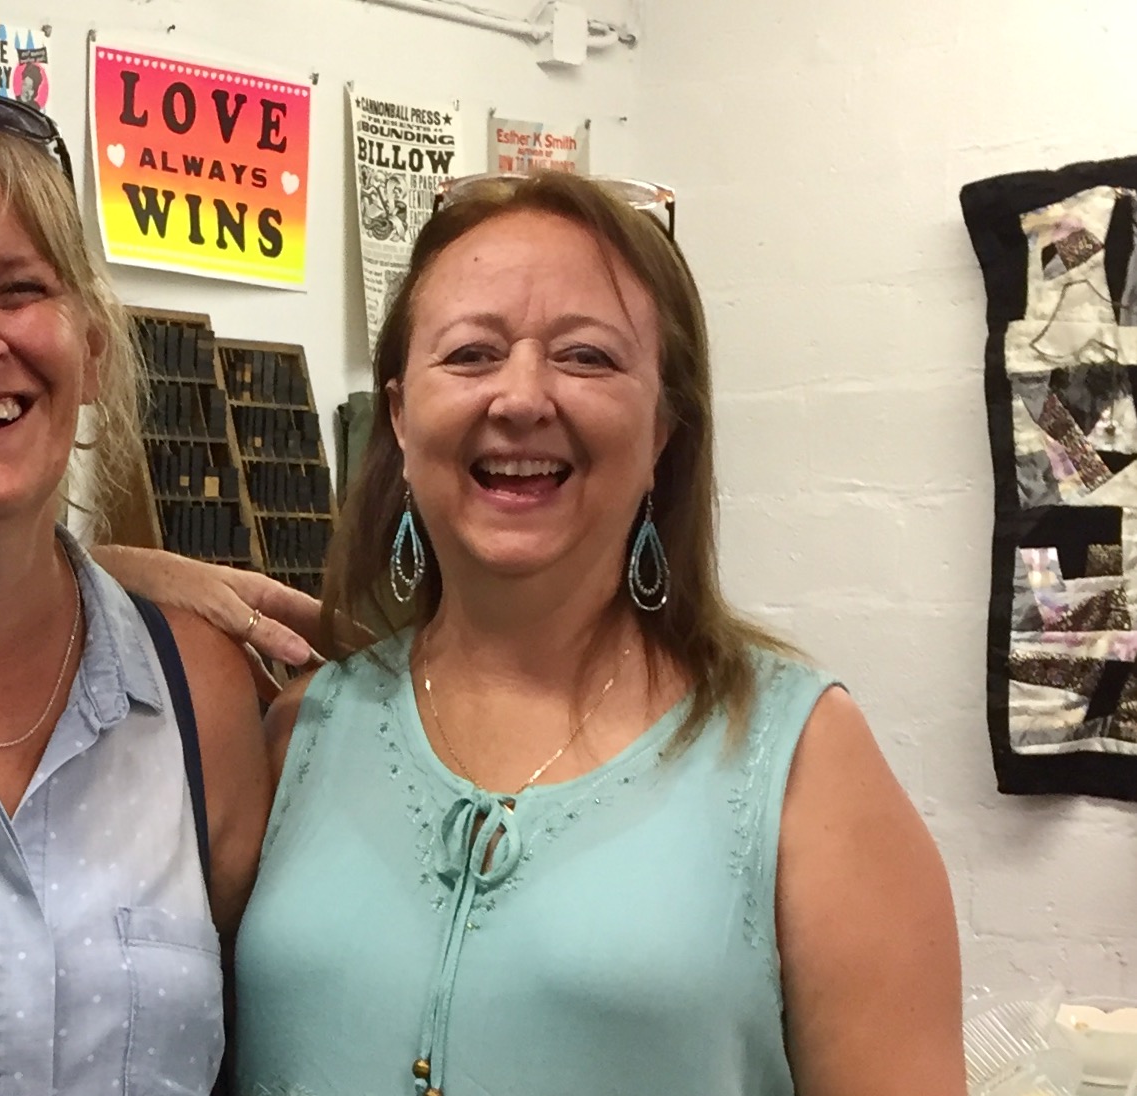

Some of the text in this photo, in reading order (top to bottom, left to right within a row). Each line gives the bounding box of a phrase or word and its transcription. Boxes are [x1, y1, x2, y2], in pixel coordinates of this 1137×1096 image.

[119, 70, 287, 154] LOVE
[361, 97, 442, 126] CANNONBALL PRESS
[361, 121, 455, 146] BOUNDING
[496, 128, 577, 150] Esther K Smith
[139, 147, 268, 189] ALWAYS
[357, 135, 455, 175] BILLOW
[122, 182, 283, 258] WINS
